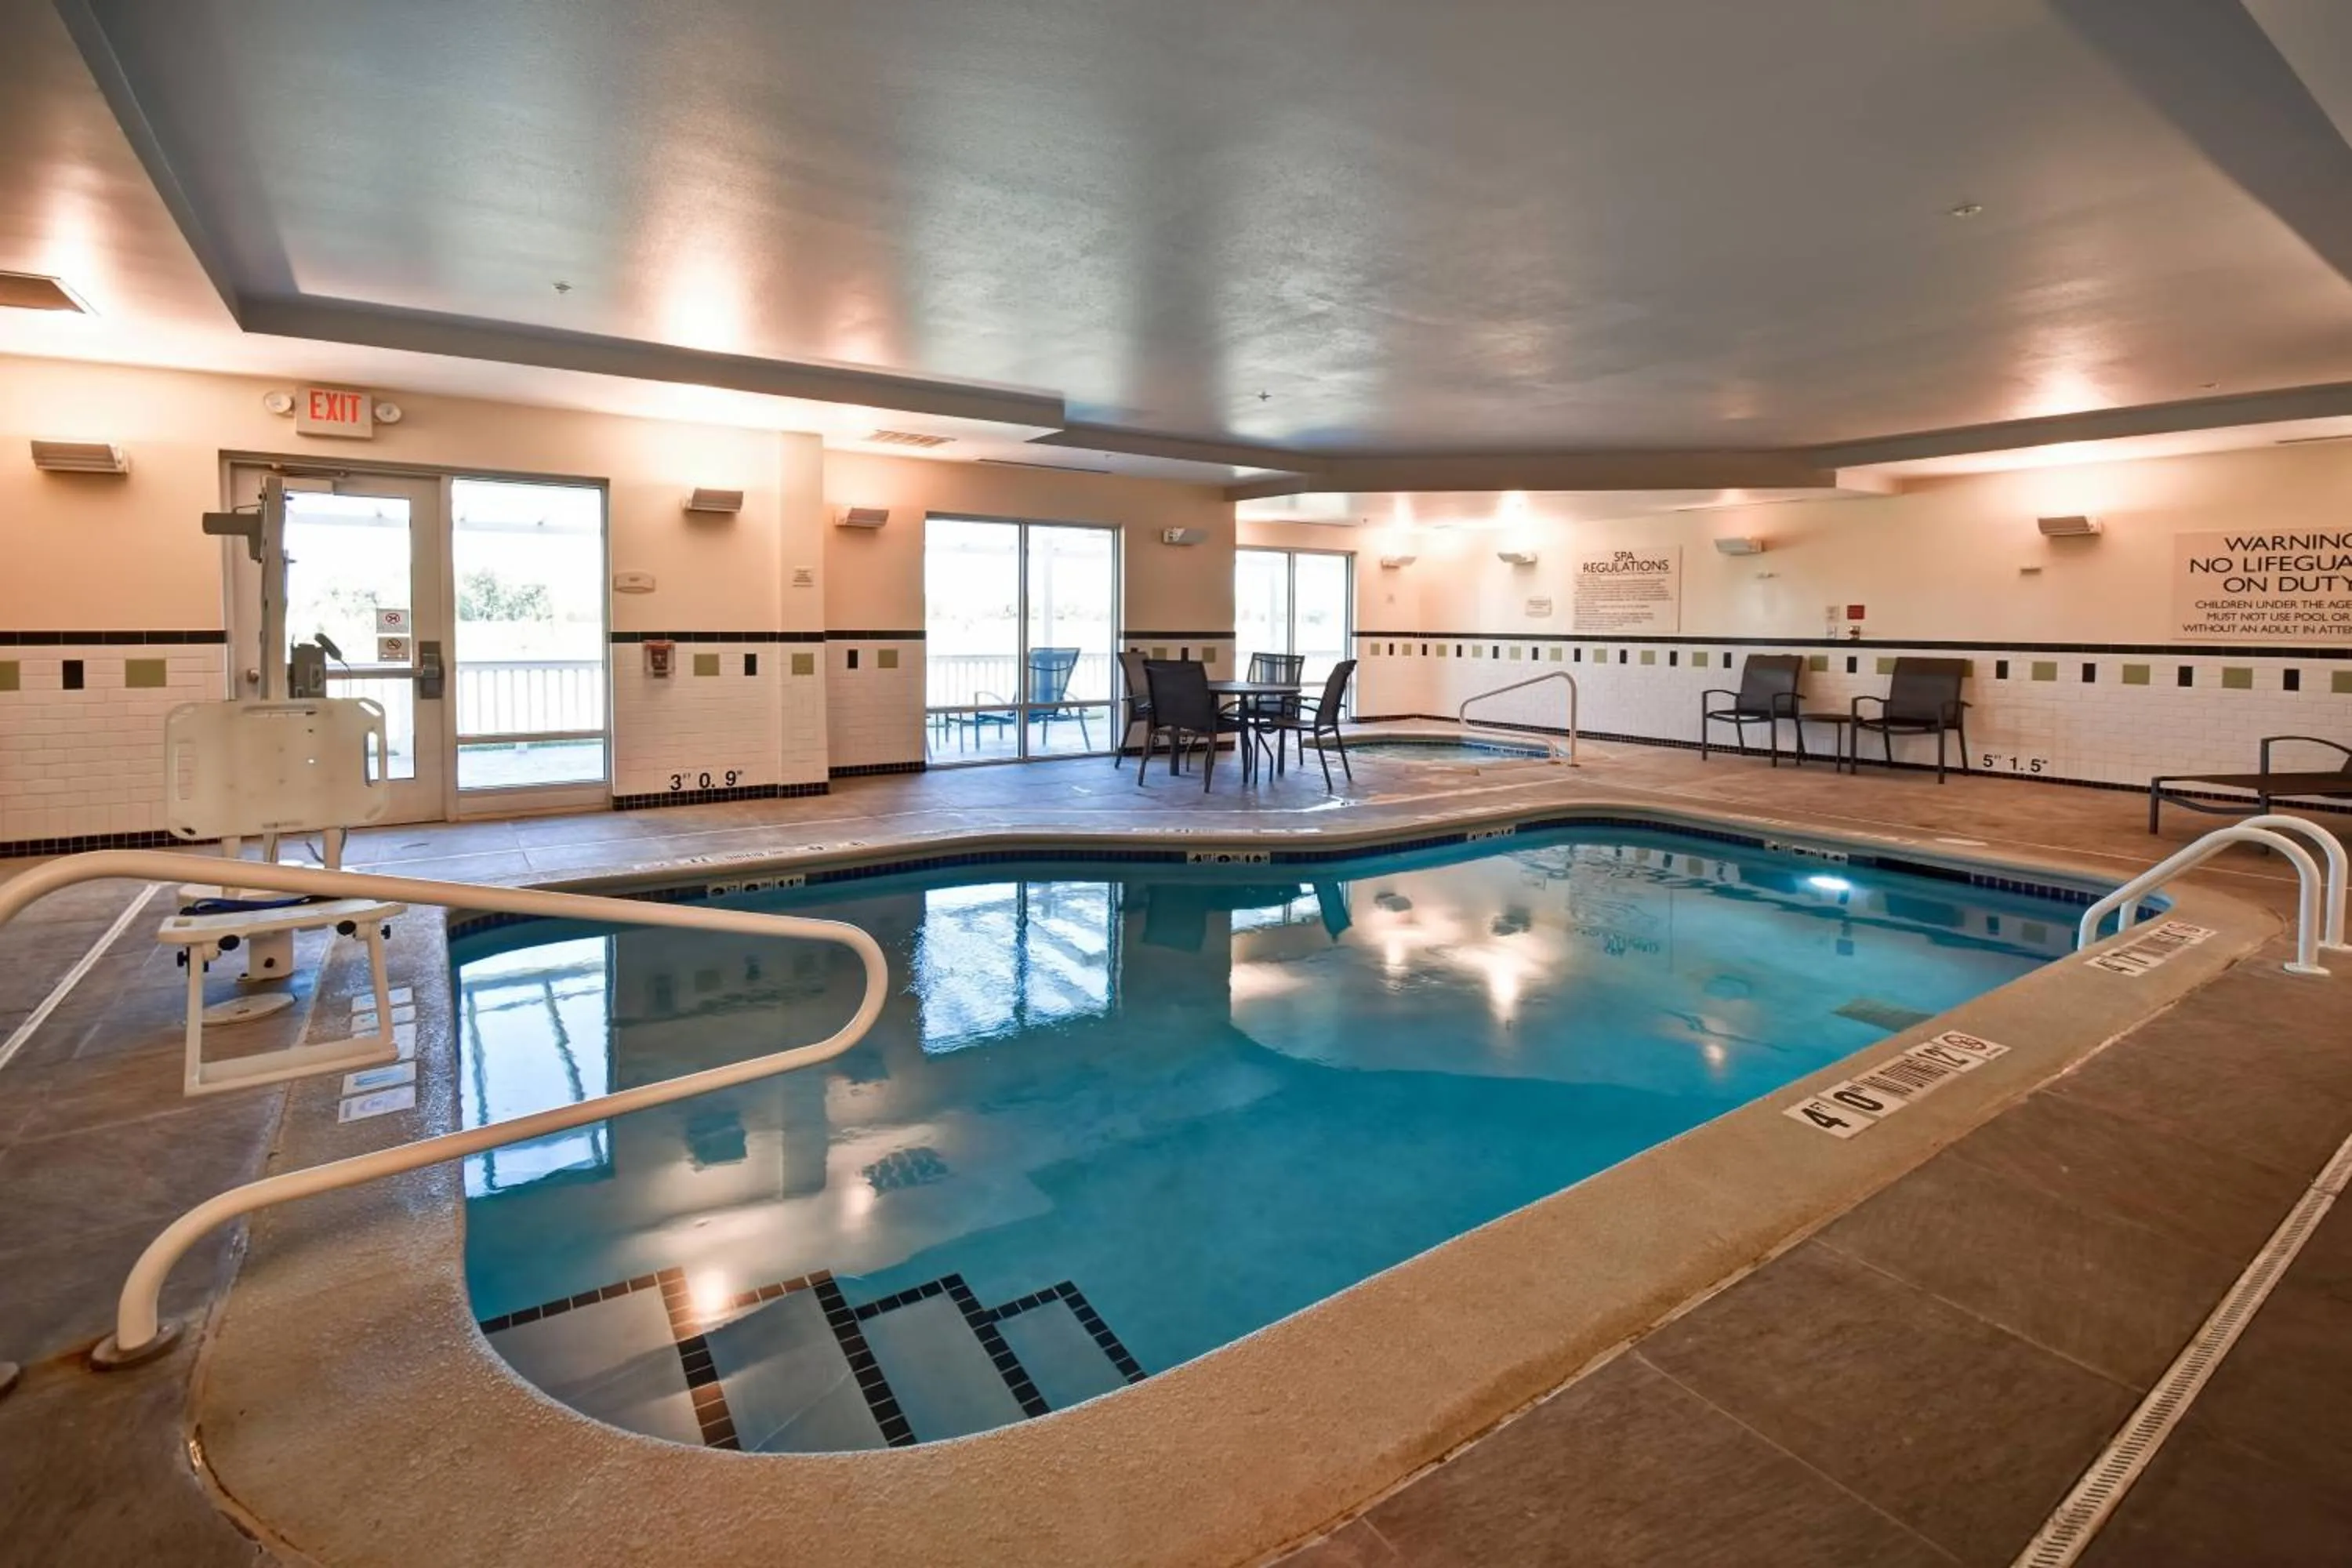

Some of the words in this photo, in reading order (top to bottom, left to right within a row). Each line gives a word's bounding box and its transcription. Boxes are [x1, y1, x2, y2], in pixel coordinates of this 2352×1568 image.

[310, 390, 361, 423] EXIT
[1614, 551, 1635, 562] SPA
[1582, 559, 1670, 573] REGULATIONS
[2190, 557, 2234, 573] NO
[2223, 576, 2267, 593] ON
[2195, 600, 2252, 609] CHILDREN
[2256, 600, 2297, 609] UNDER
[2301, 600, 2325, 609] THE
[2328, 600, 2352, 609] AGE
[2207, 612, 2237, 622] MUST
[2241, 612, 2267, 622] NOT
[2270, 612, 2291, 622] USE
[2294, 612, 2328, 622] POOL
[2331, 612, 2350, 622] OR
[2182, 622, 2238, 633] WITHOUT
[2240, 624, 2258, 633] AN
[2259, 625, 2298, 633] ADULT
[2303, 625, 2315, 634] IN
[2318, 624, 2352, 634] ATTE
